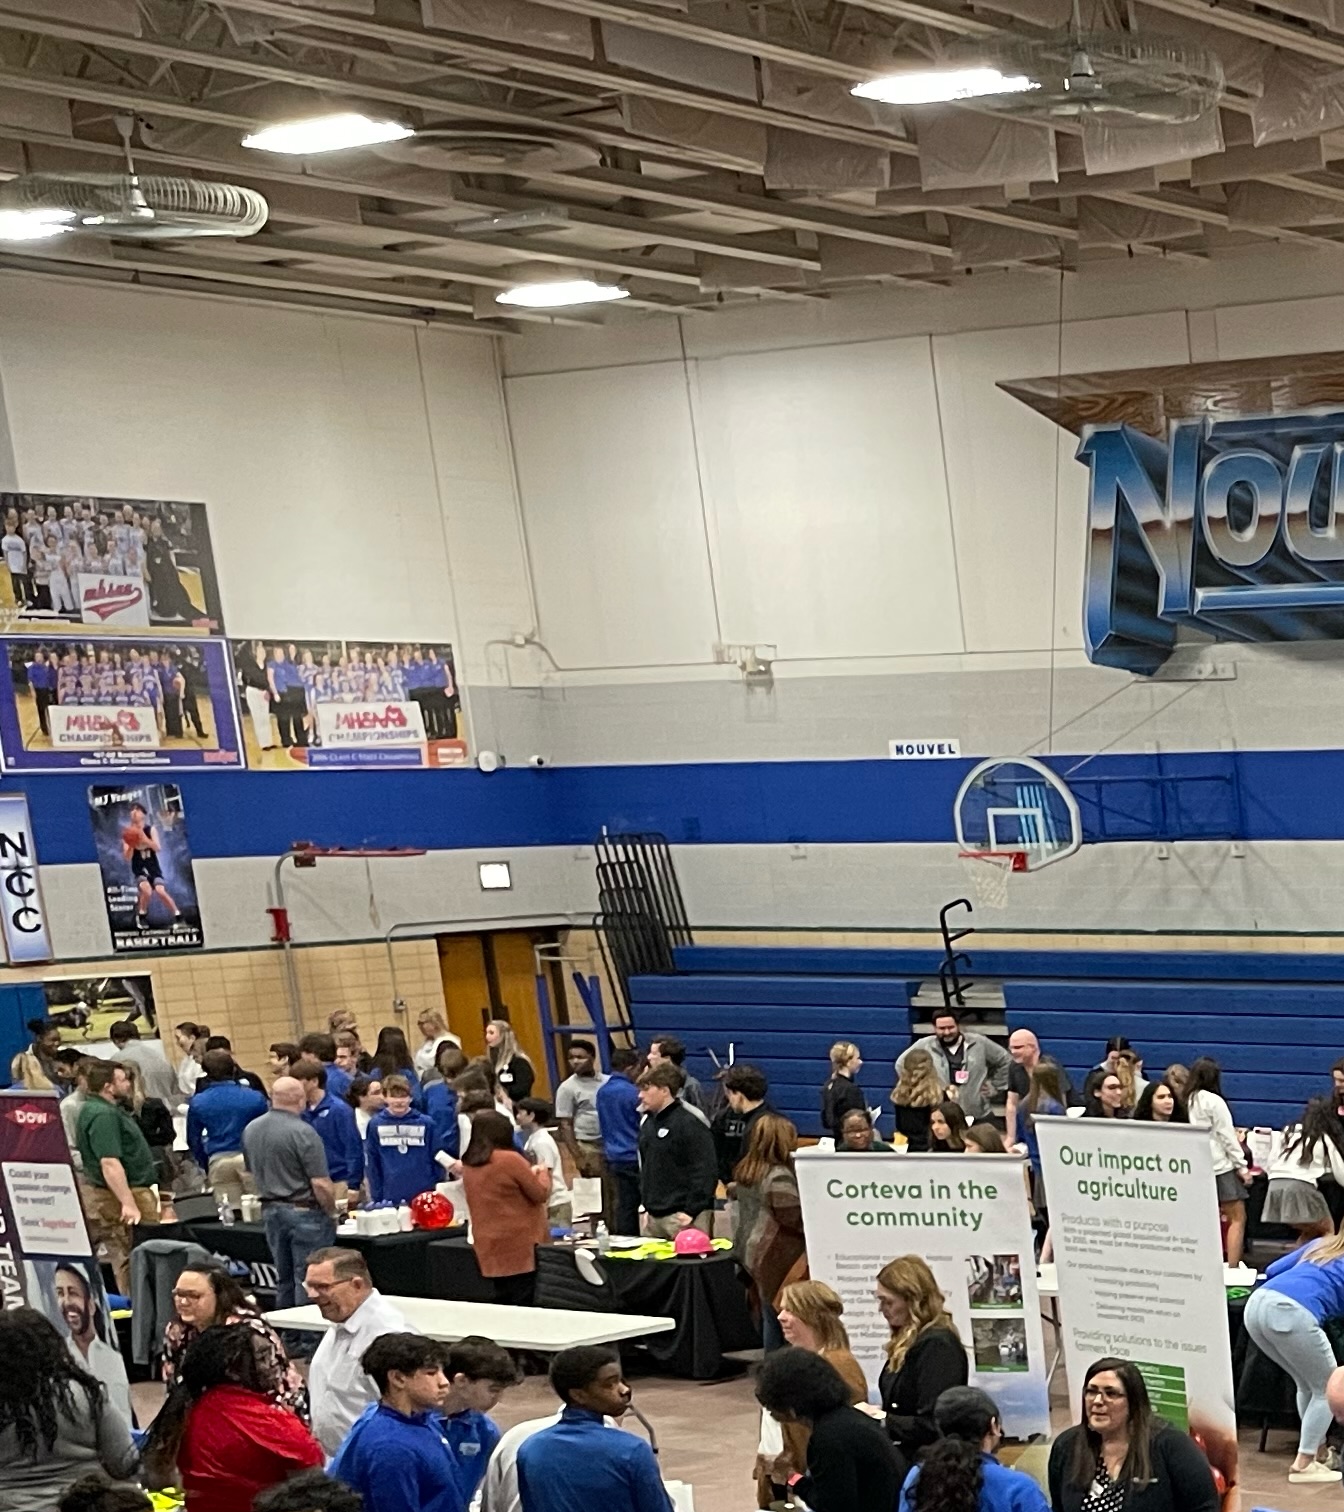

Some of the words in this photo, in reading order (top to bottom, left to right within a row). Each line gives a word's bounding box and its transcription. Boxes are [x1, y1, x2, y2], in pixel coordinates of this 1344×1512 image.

[895, 743, 956, 756] NOUVEL
[116, 933, 202, 949] BASKETBALL
[15, 1110, 47, 1124] DOW
[1060, 1145, 1093, 1168] Our
[1097, 1148, 1163, 1175] impact
[1169, 1157, 1192, 1174] on
[826, 1179, 922, 1198] Corteva
[930, 1179, 951, 1199] in
[958, 1180, 998, 1200] the
[1077, 1176, 1178, 1201] agriculture
[846, 1207, 983, 1232] community
